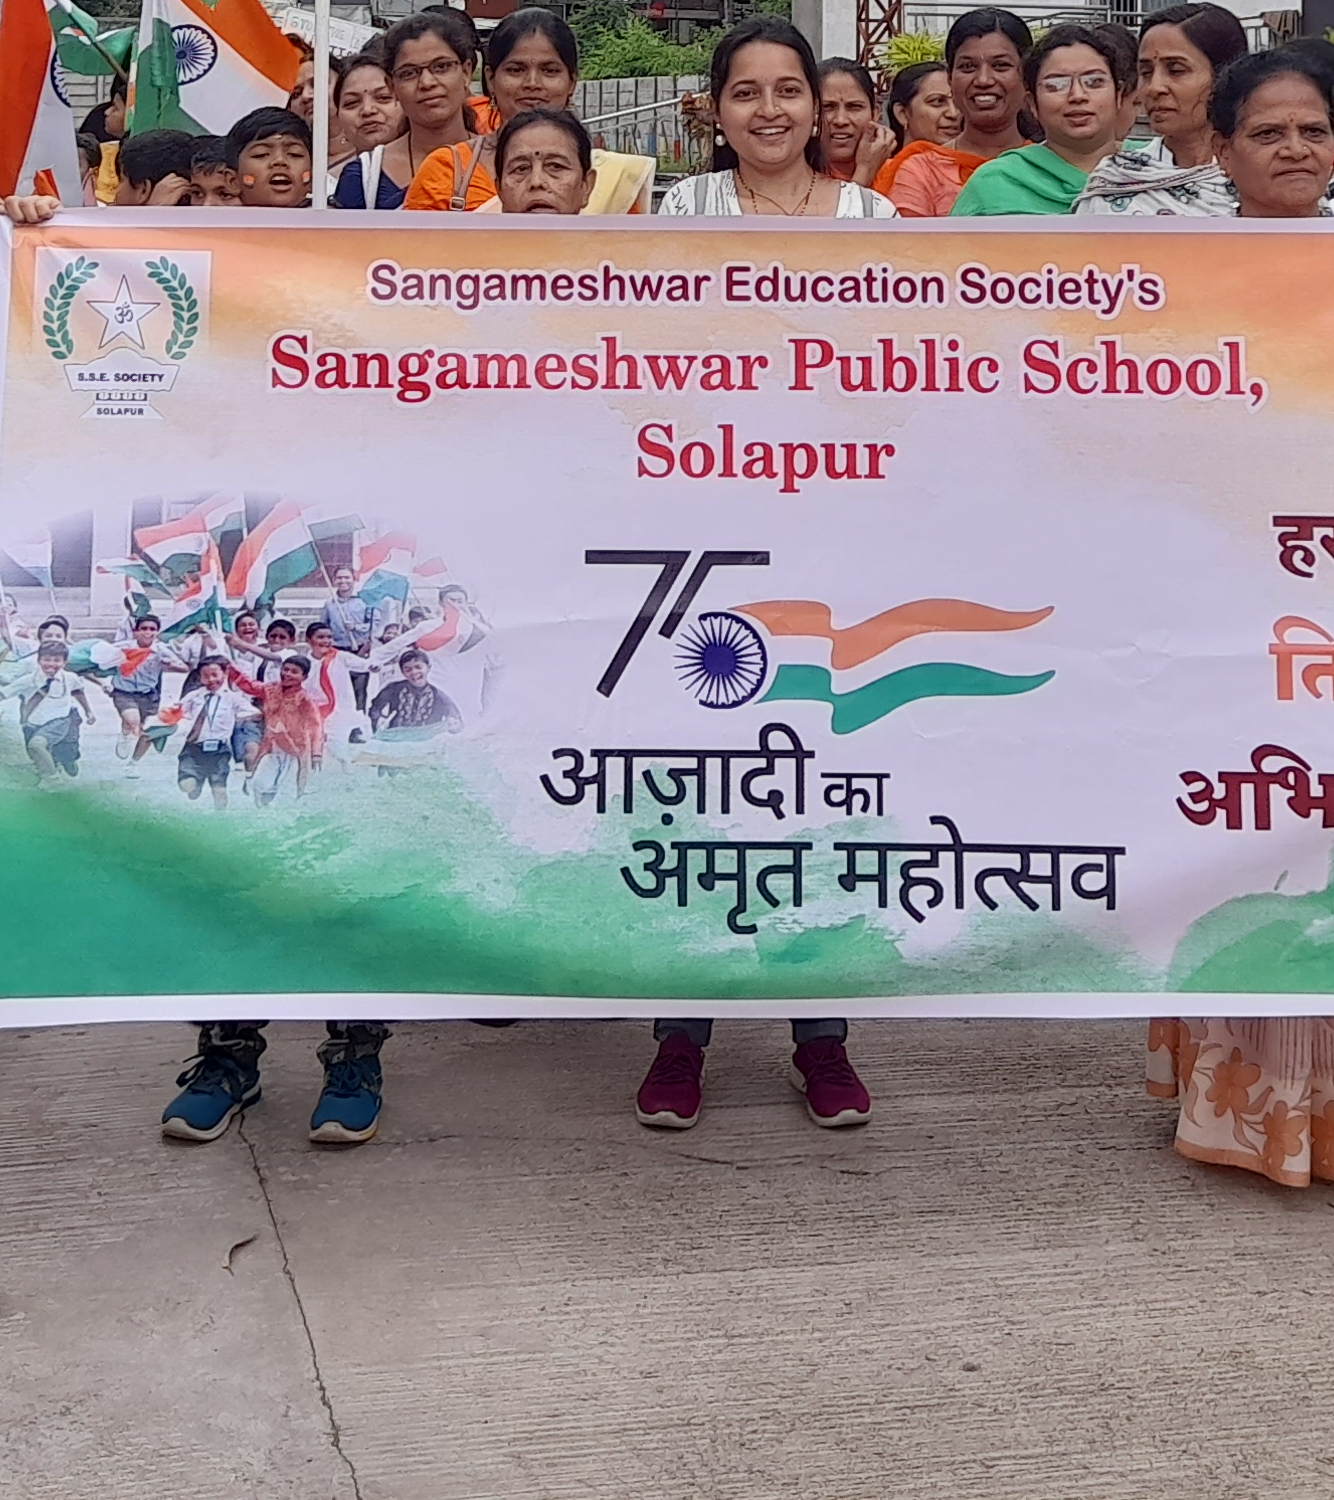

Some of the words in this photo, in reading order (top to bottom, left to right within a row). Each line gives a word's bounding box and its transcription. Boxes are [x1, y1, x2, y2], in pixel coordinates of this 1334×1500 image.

[370, 263, 711, 311] Sangameshwar
[725, 265, 945, 304] Education
[959, 267, 1160, 313] Society's
[113, 372, 165, 383] SOCIETY
[271, 334, 770, 404] Sangameshwar
[787, 337, 1000, 394] Public
[1022, 339, 1265, 407] School,
[96, 407, 144, 416] SOLAPUR
[637, 422, 896, 494] Solapur
[820, 771, 891, 817] का
[619, 839, 814, 935] अमृत
[832, 814, 1127, 924] महोत्सव
